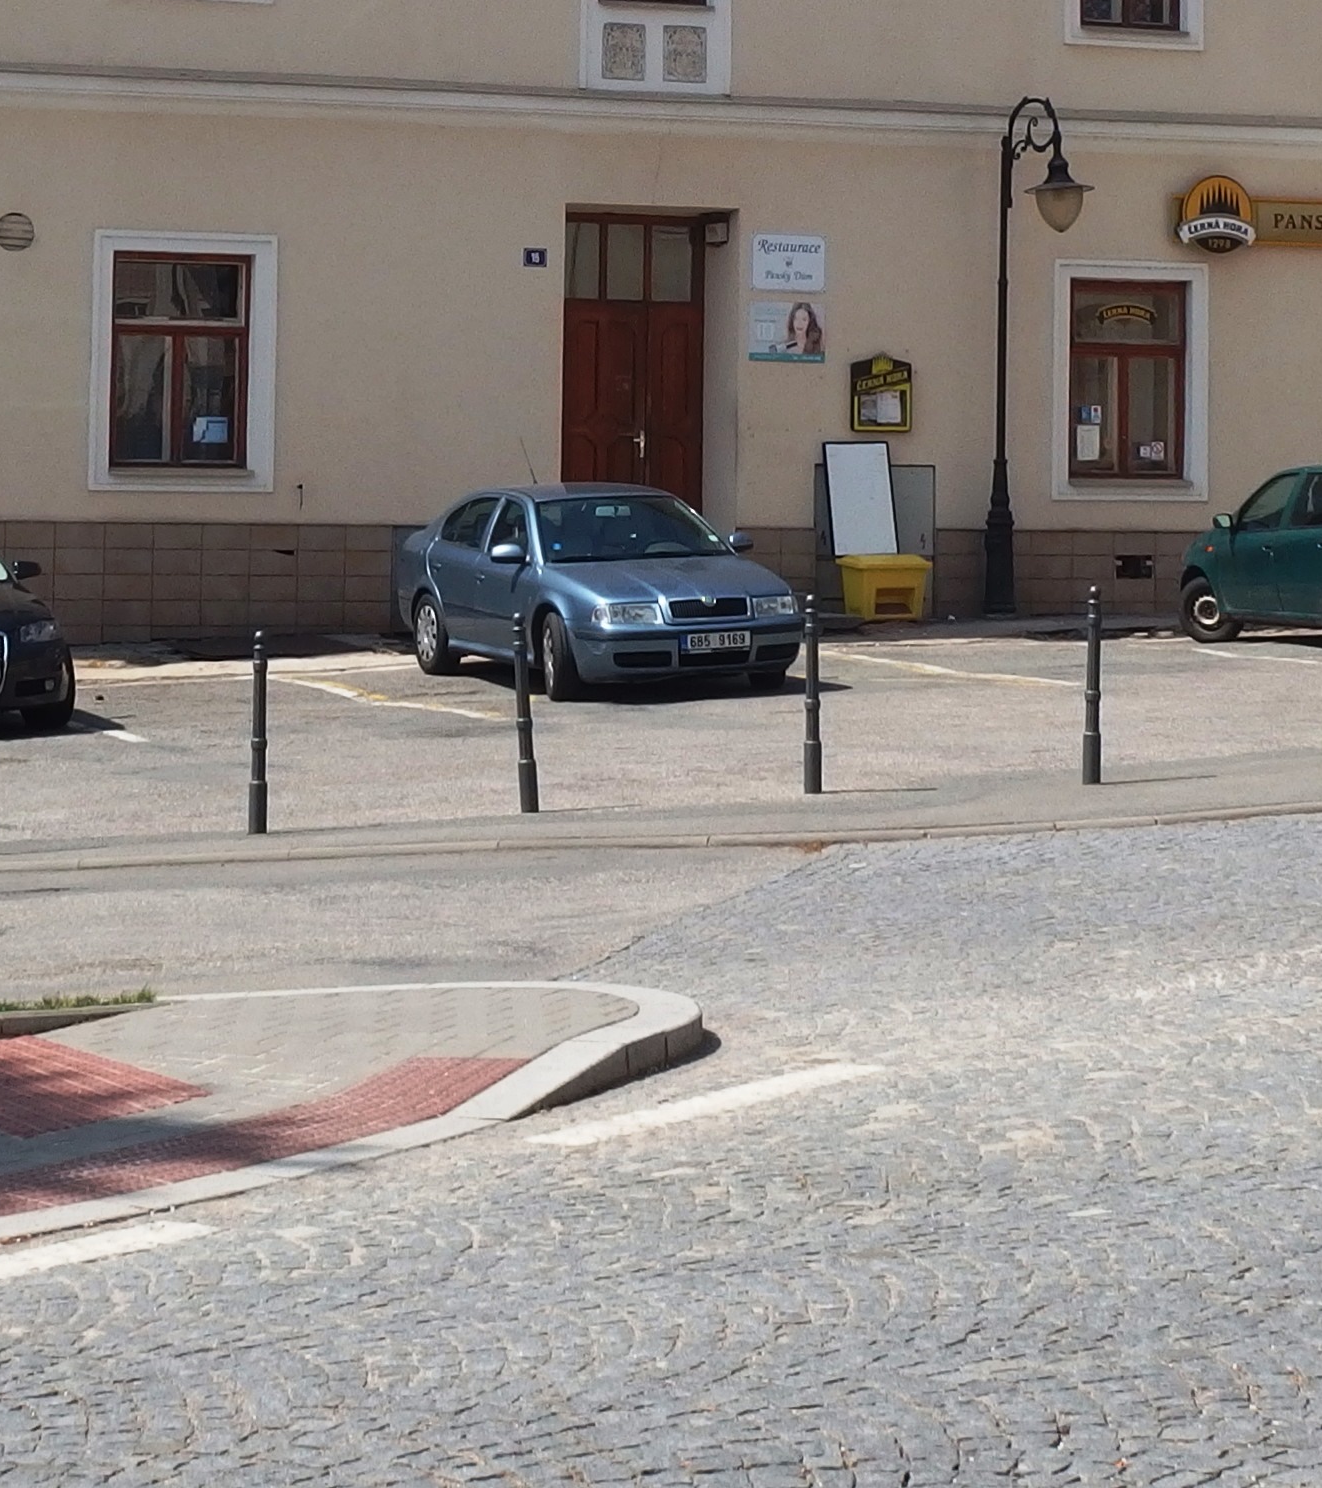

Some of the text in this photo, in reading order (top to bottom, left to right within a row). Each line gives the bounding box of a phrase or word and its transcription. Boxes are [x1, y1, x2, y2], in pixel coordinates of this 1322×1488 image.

[1223, 222, 1249, 236] HORA
[758, 239, 821, 255] Restaurace
[690, 633, 746, 647] 6B5 9169
